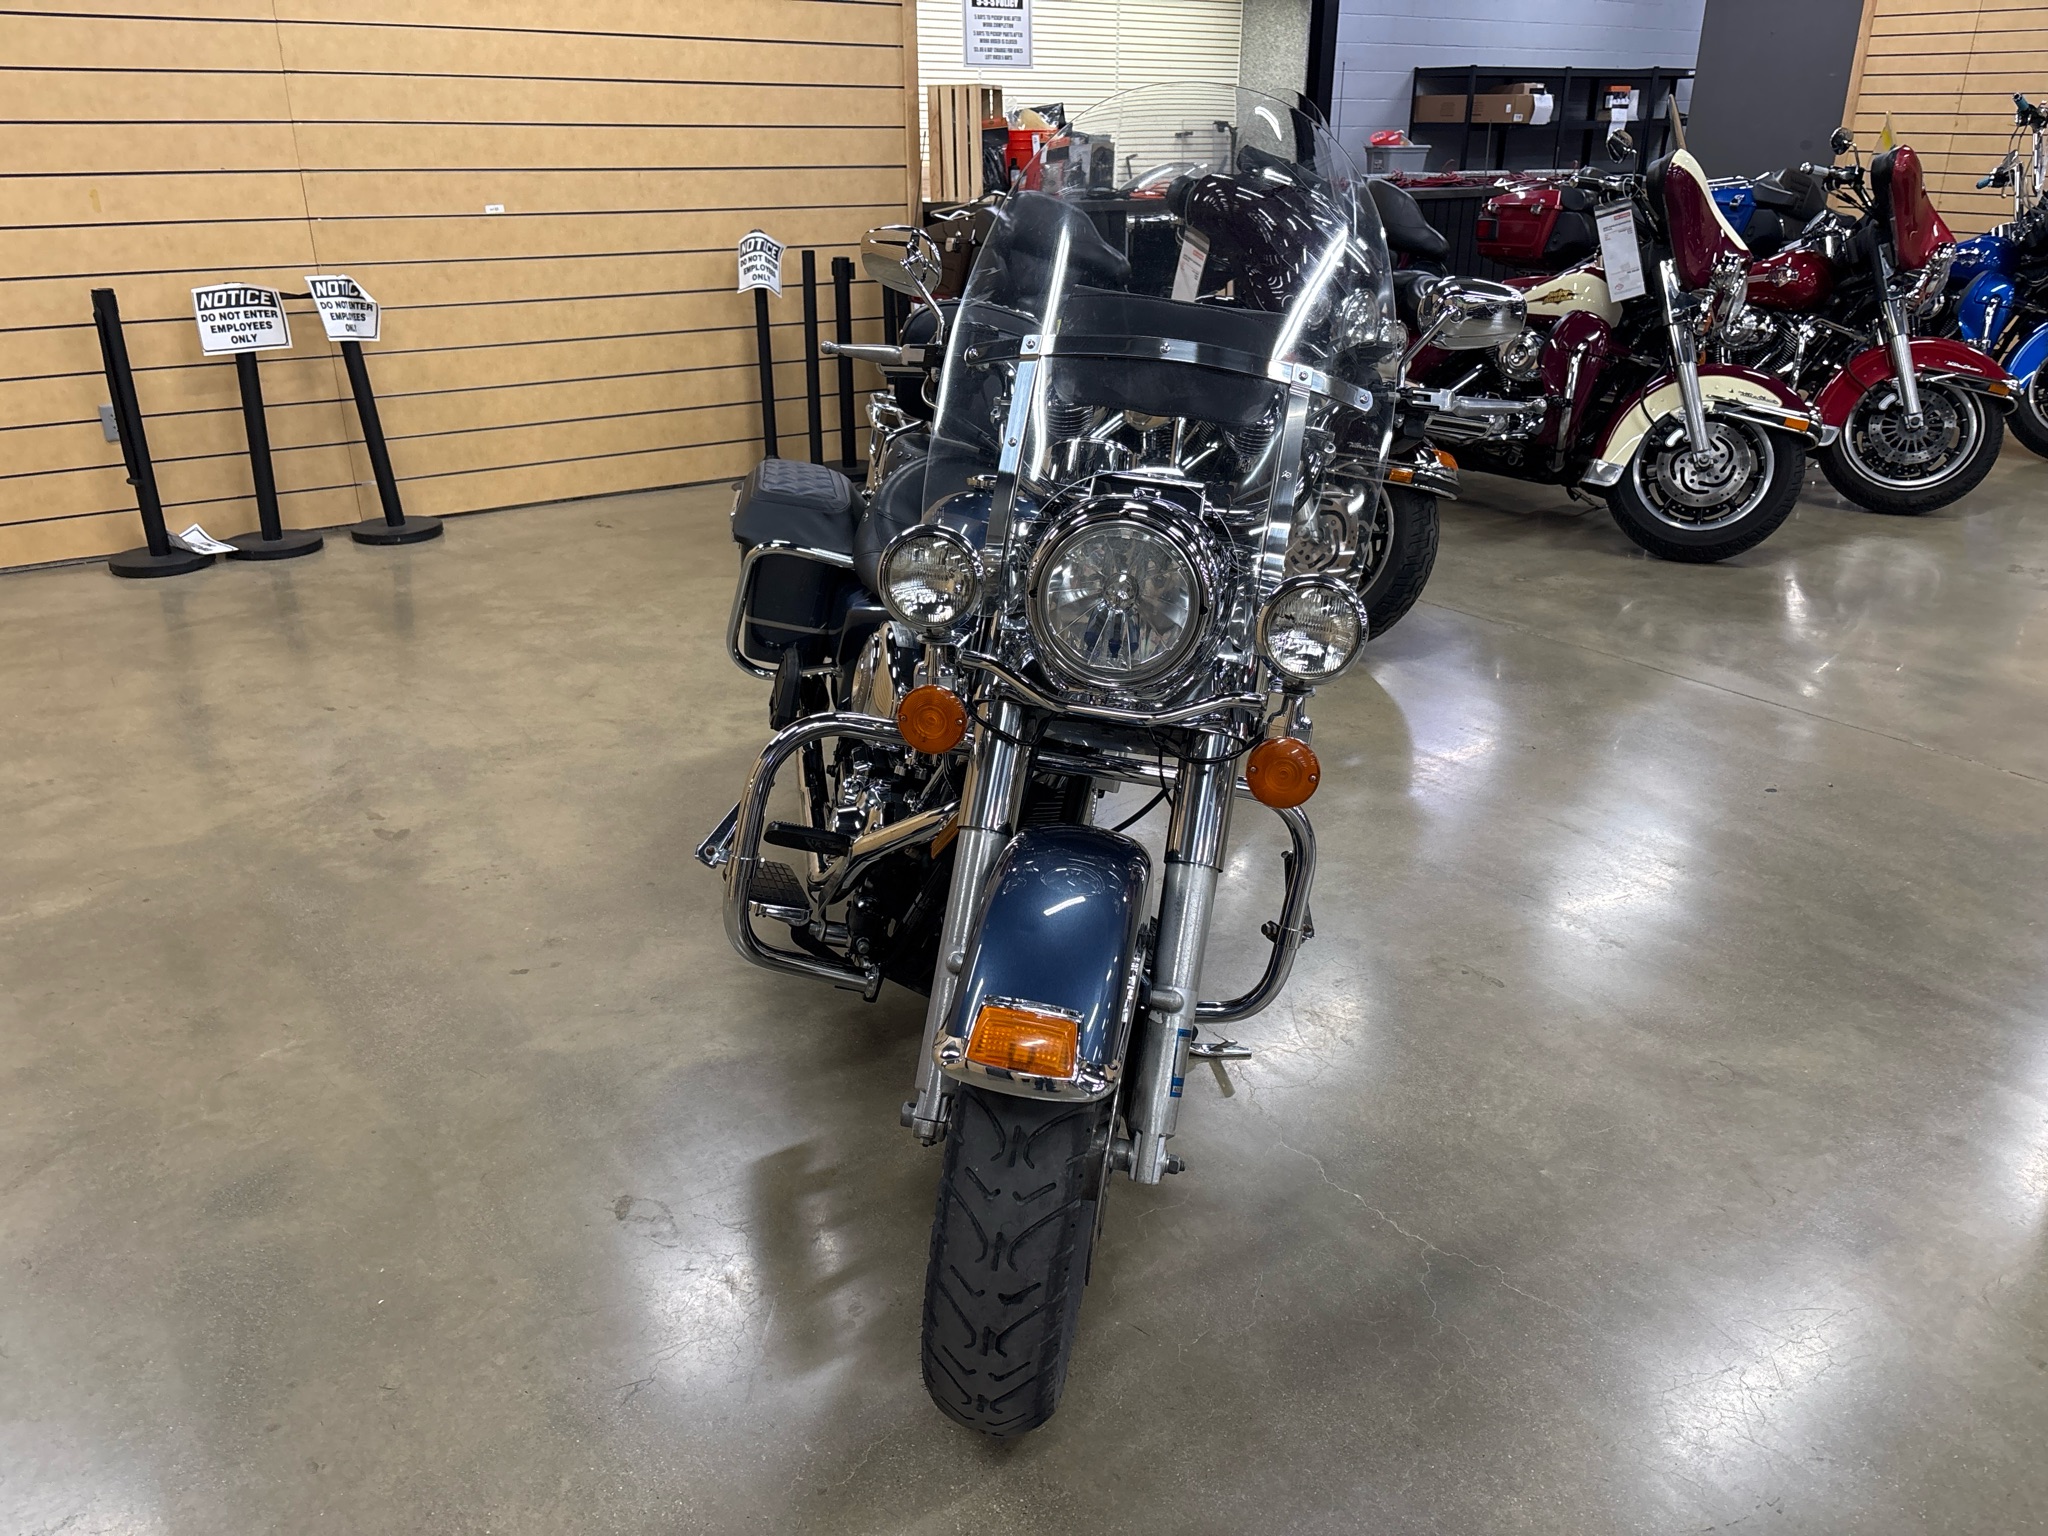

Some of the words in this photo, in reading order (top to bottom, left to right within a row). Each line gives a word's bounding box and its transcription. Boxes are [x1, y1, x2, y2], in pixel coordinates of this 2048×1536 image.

[741, 238, 778, 259] NOTICE
[740, 258, 747, 267] DO
[748, 254, 763, 263] NOT
[744, 264, 776, 278] EMPLOYEES
[752, 273, 770, 282] ONLY
[316, 281, 361, 296] NOTIC
[200, 290, 271, 309] NOTICE
[320, 301, 333, 309] DO
[201, 313, 216, 322] DO
[219, 311, 241, 321] NOT
[244, 310, 278, 319] ENTER
[210, 321, 273, 334] EMPLOYEES
[231, 334, 257, 344] ONLY
